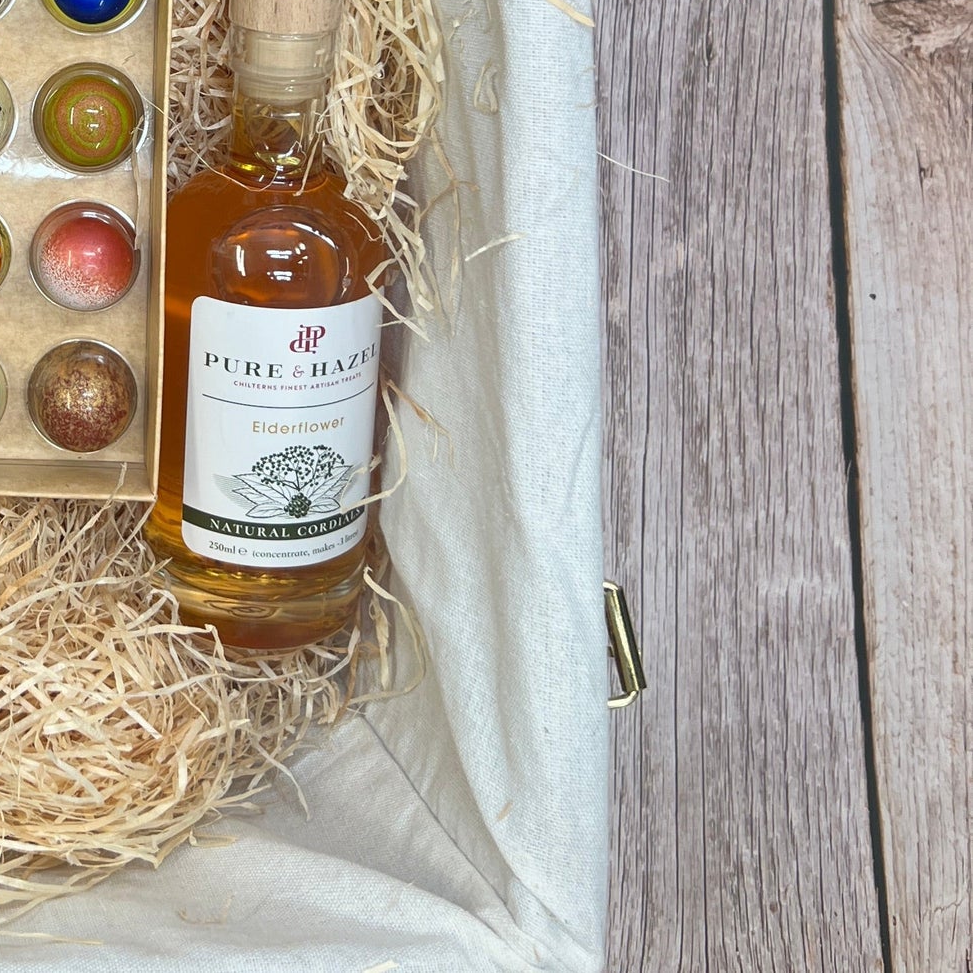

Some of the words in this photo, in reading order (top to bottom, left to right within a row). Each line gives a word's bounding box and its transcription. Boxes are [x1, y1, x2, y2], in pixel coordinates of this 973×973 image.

[203, 351, 283, 379] PURE
[292, 364, 305, 379] &
[309, 342, 377, 377] HAZEL
[233, 380, 278, 391] CHILTERNS
[310, 379, 340, 390] ARTISAN
[341, 371, 363, 384] TREATS
[251, 416, 346, 435] Elderflower
[209, 518, 291, 538] NATURAL
[297, 507, 361, 536] CORDIALS
[208, 540, 237, 555] 250ml
[252, 549, 311, 559] (concentrate,
[312, 542, 336, 555] makes
